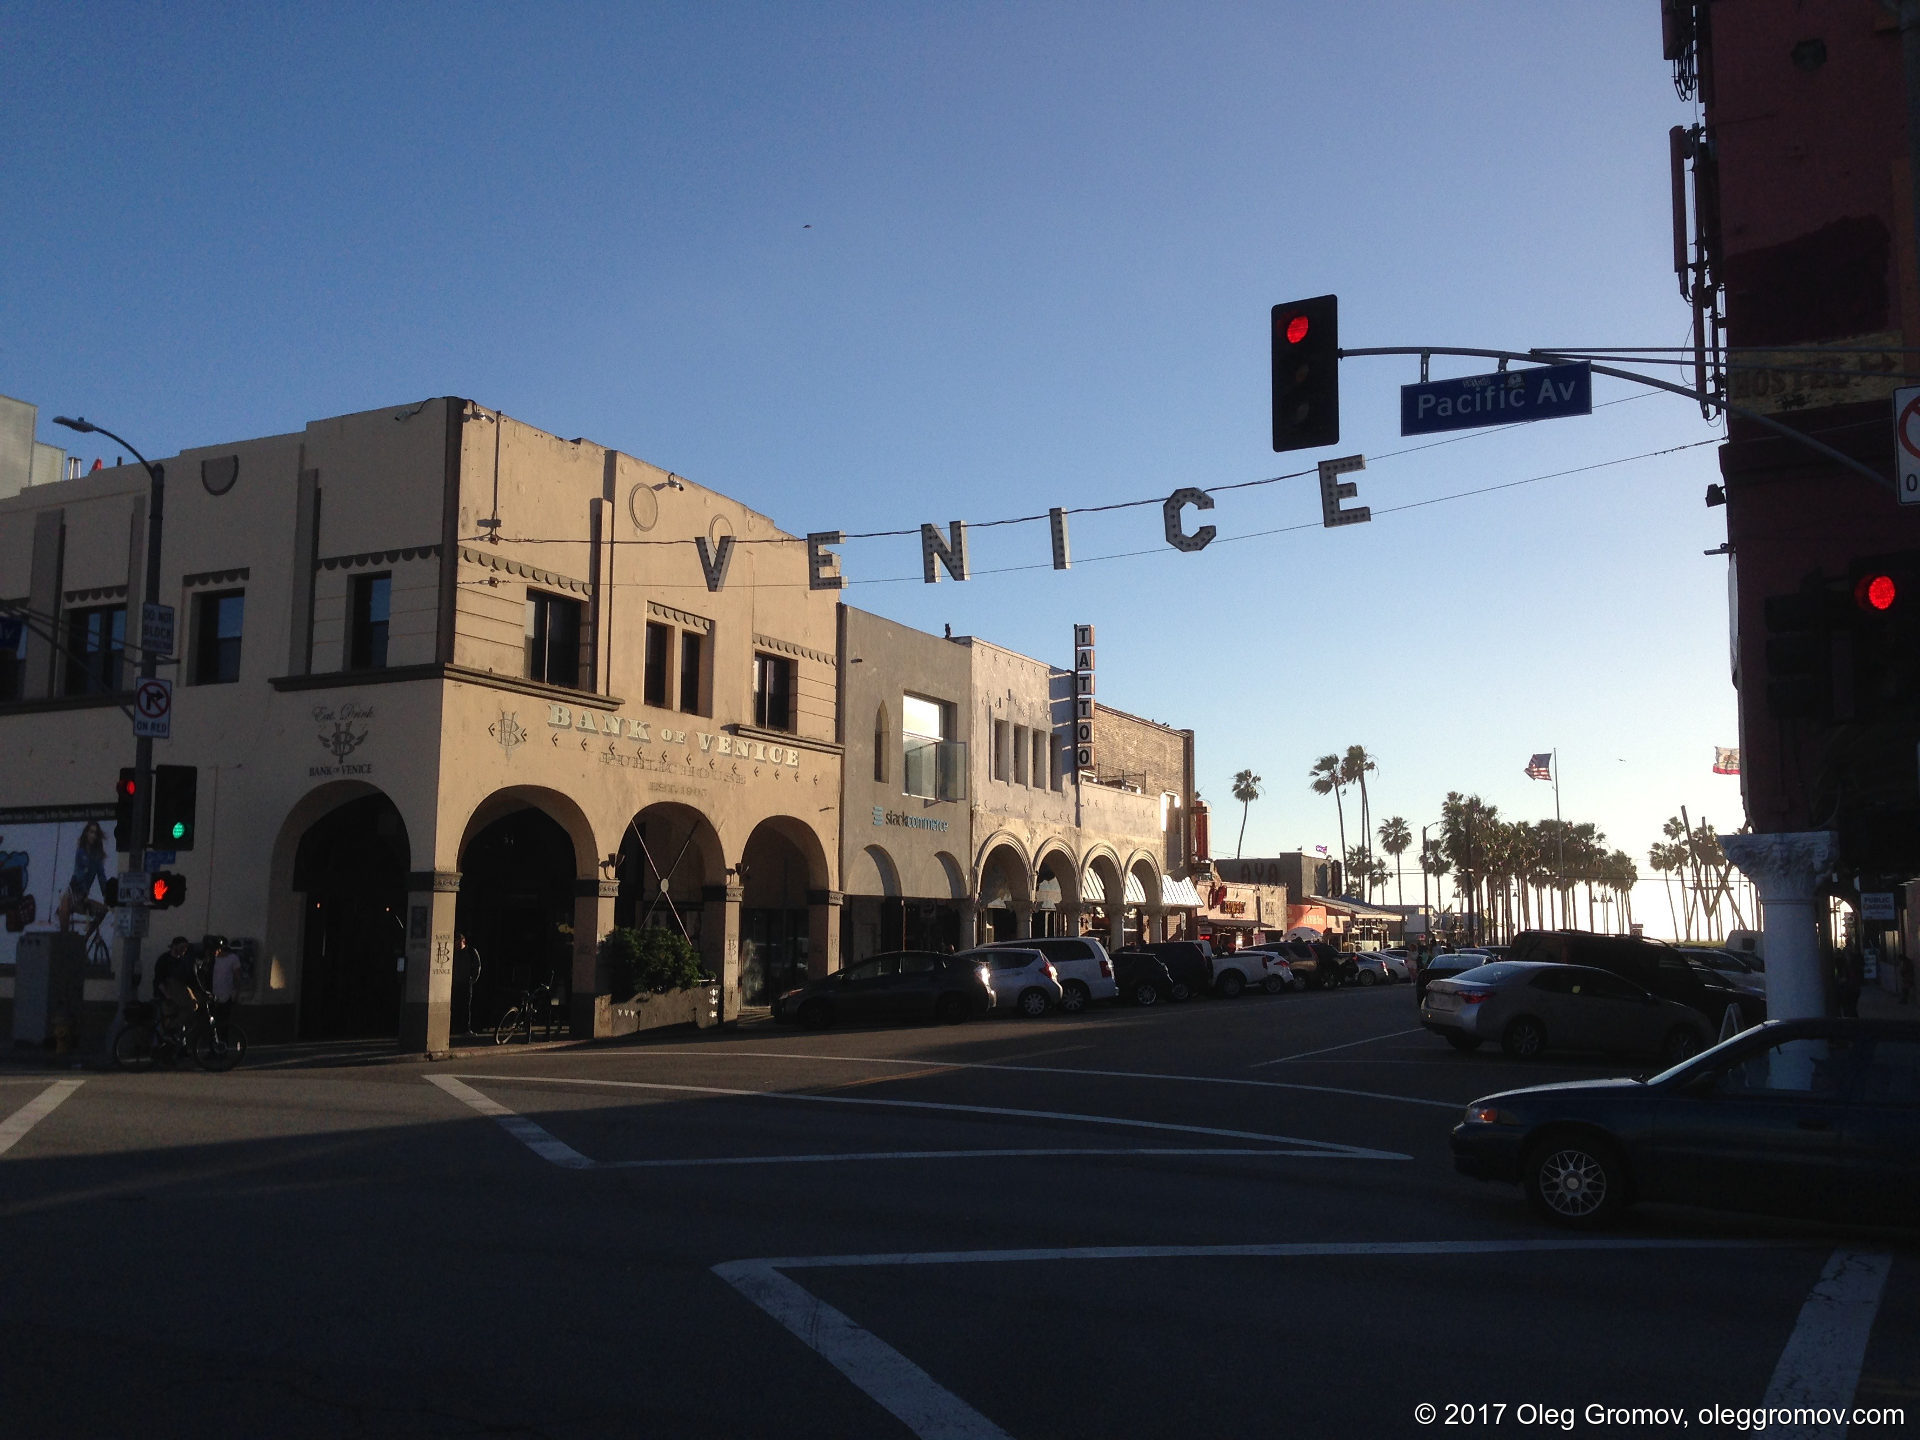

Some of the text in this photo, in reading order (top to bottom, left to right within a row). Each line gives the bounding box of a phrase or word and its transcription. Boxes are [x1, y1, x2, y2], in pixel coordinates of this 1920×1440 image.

[1417, 378, 1576, 420] Pacific Av
[695, 455, 1370, 592] VENICE
[1078, 627, 1090, 765] TATTOO
[136, 720, 167, 734] ON RED
[547, 703, 651, 743] BANK
[696, 731, 800, 767] VENICE
[309, 767, 332, 777] BANK
[341, 764, 372, 776] VENICE
[885, 810, 949, 832] stackcommerce
